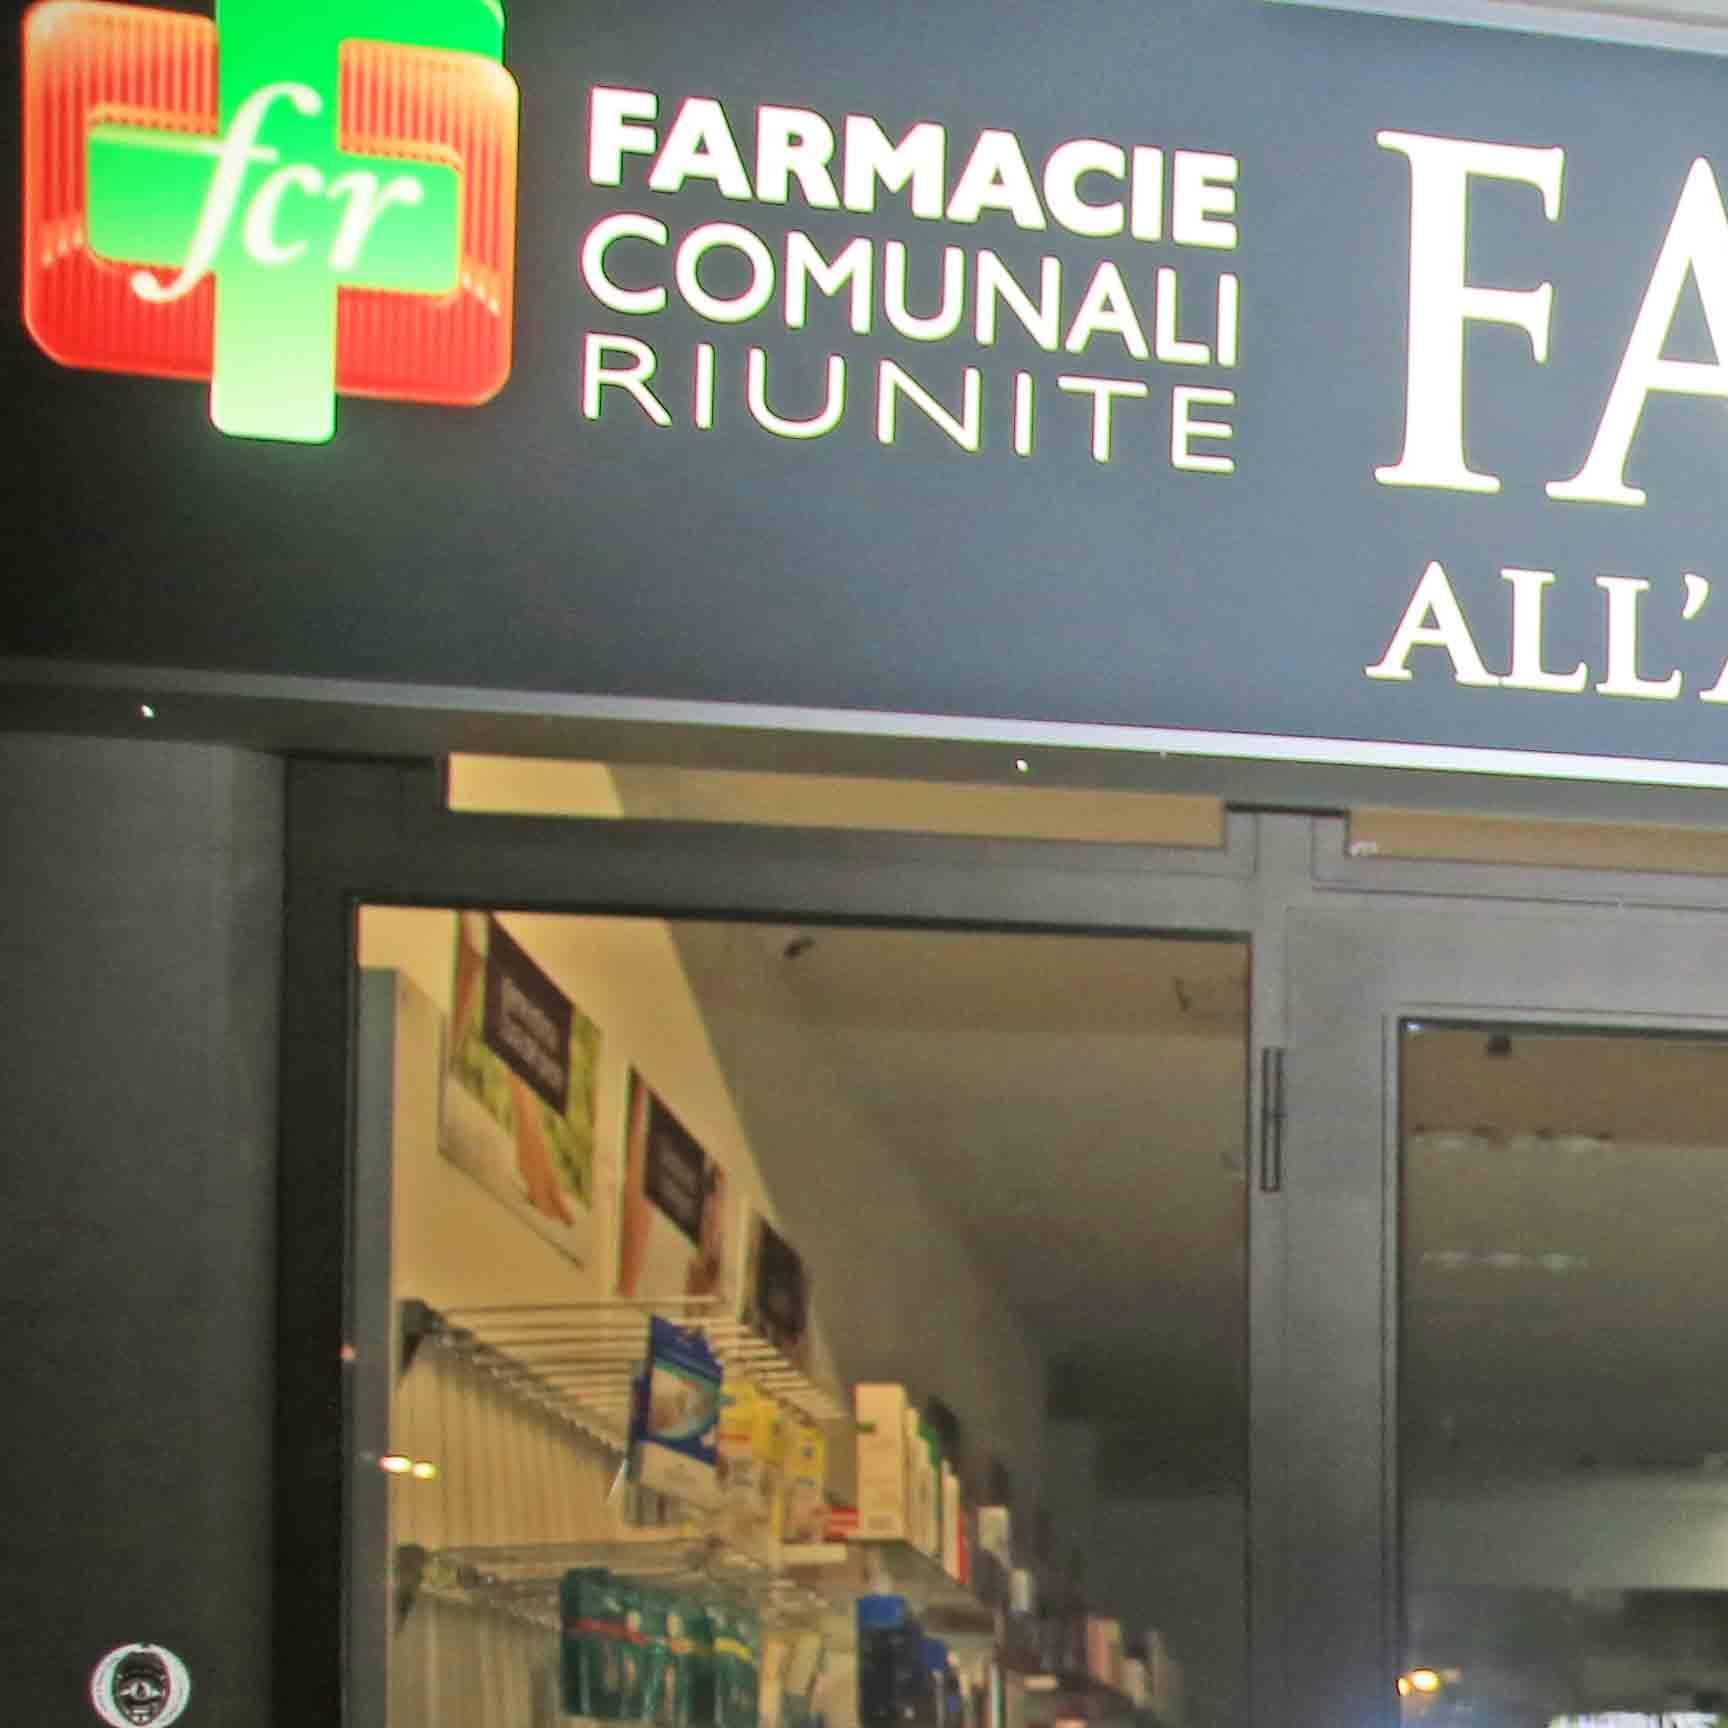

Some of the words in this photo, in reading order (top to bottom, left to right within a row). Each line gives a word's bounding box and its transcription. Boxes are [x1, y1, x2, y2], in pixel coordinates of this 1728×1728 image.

[131, 81, 422, 304] fcr
[588, 86, 1239, 249] FARMACIE
[581, 213, 1239, 368] COMUNALI
[583, 331, 1238, 474] RIUNITE
